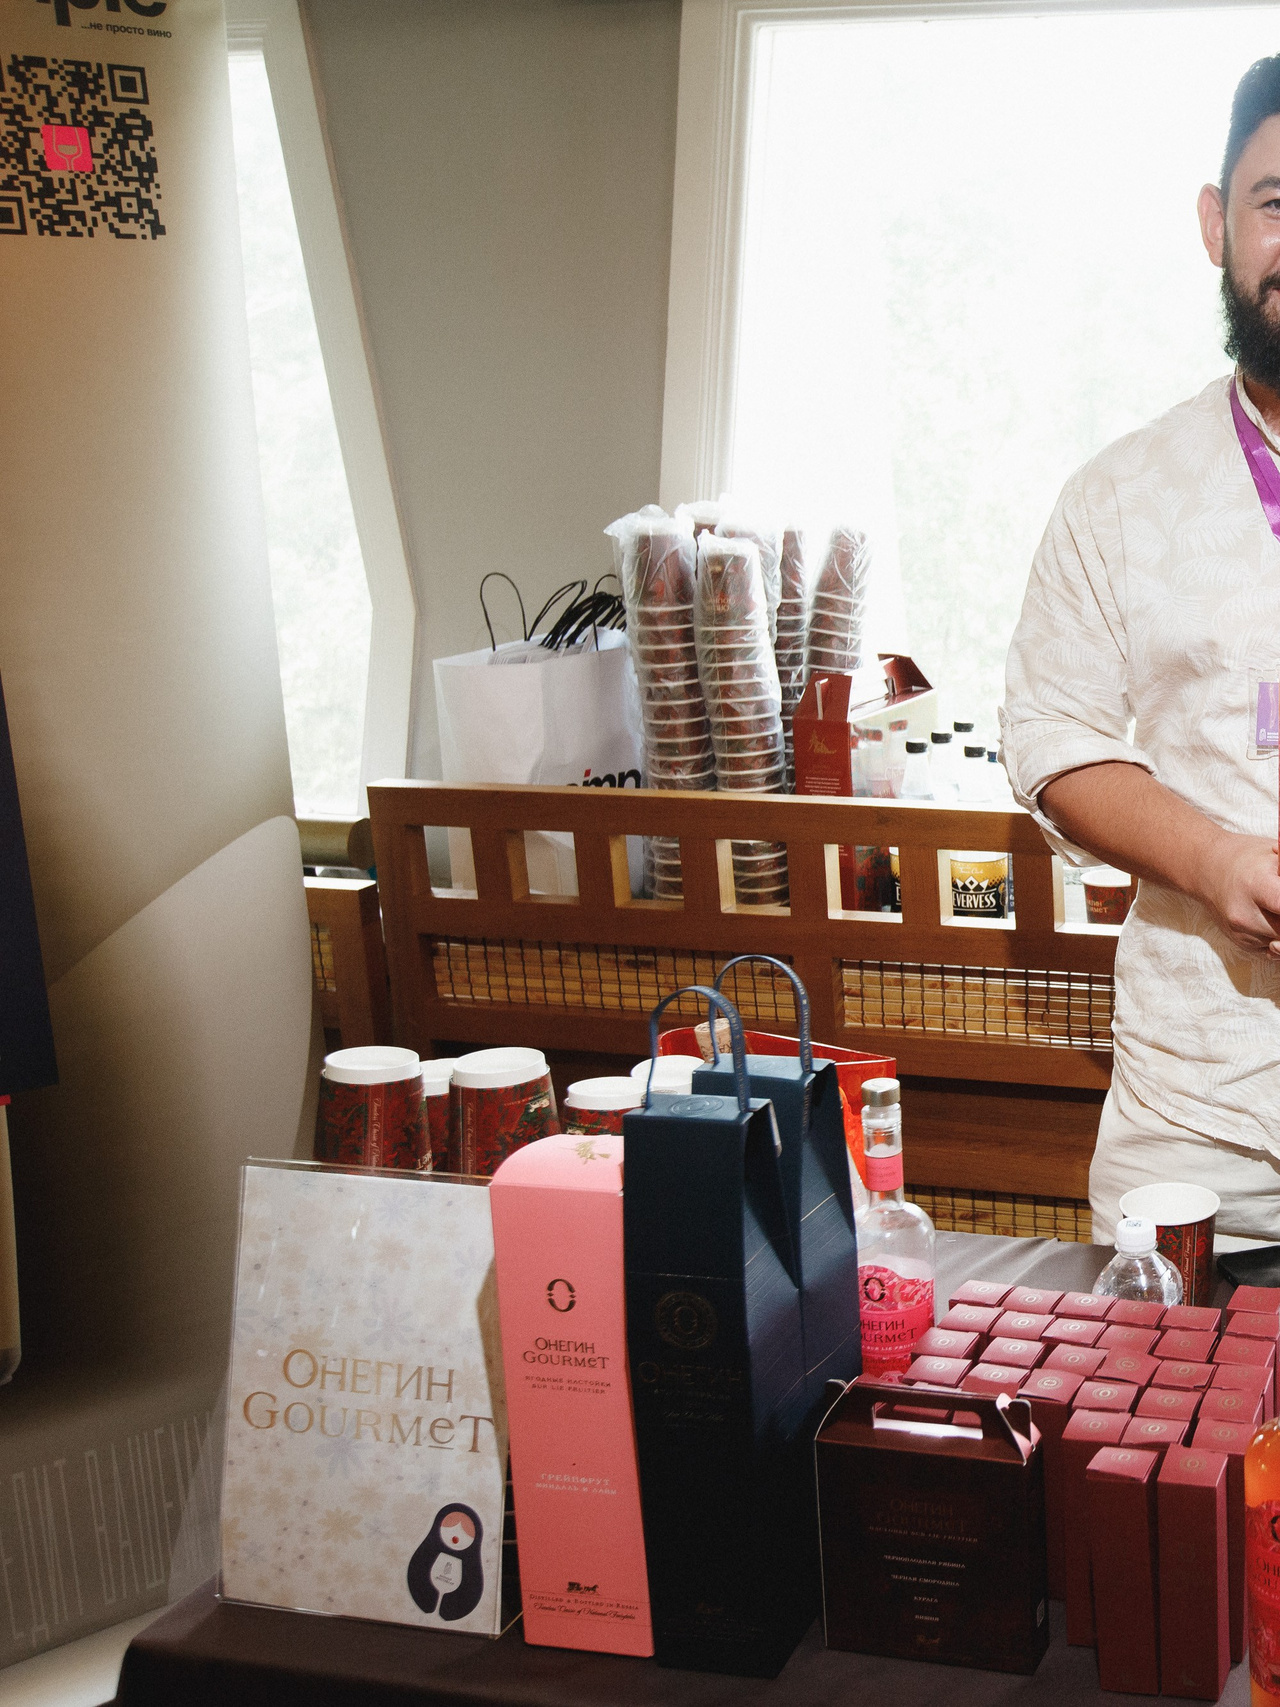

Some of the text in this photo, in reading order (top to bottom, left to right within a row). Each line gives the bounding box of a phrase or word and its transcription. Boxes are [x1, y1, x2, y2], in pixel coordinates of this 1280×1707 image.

[106, 22, 145, 35] просто
[147, 28, 172, 39] вино
[952, 890, 997, 909] EVERVESS
[860, 1319, 905, 1332] НЕГИН
[534, 1337, 595, 1354] ОНЕГИН
[283, 1348, 455, 1404] ОНЕГИН
[540, 1473, 611, 1486] ГРЕЙПФРУТ
